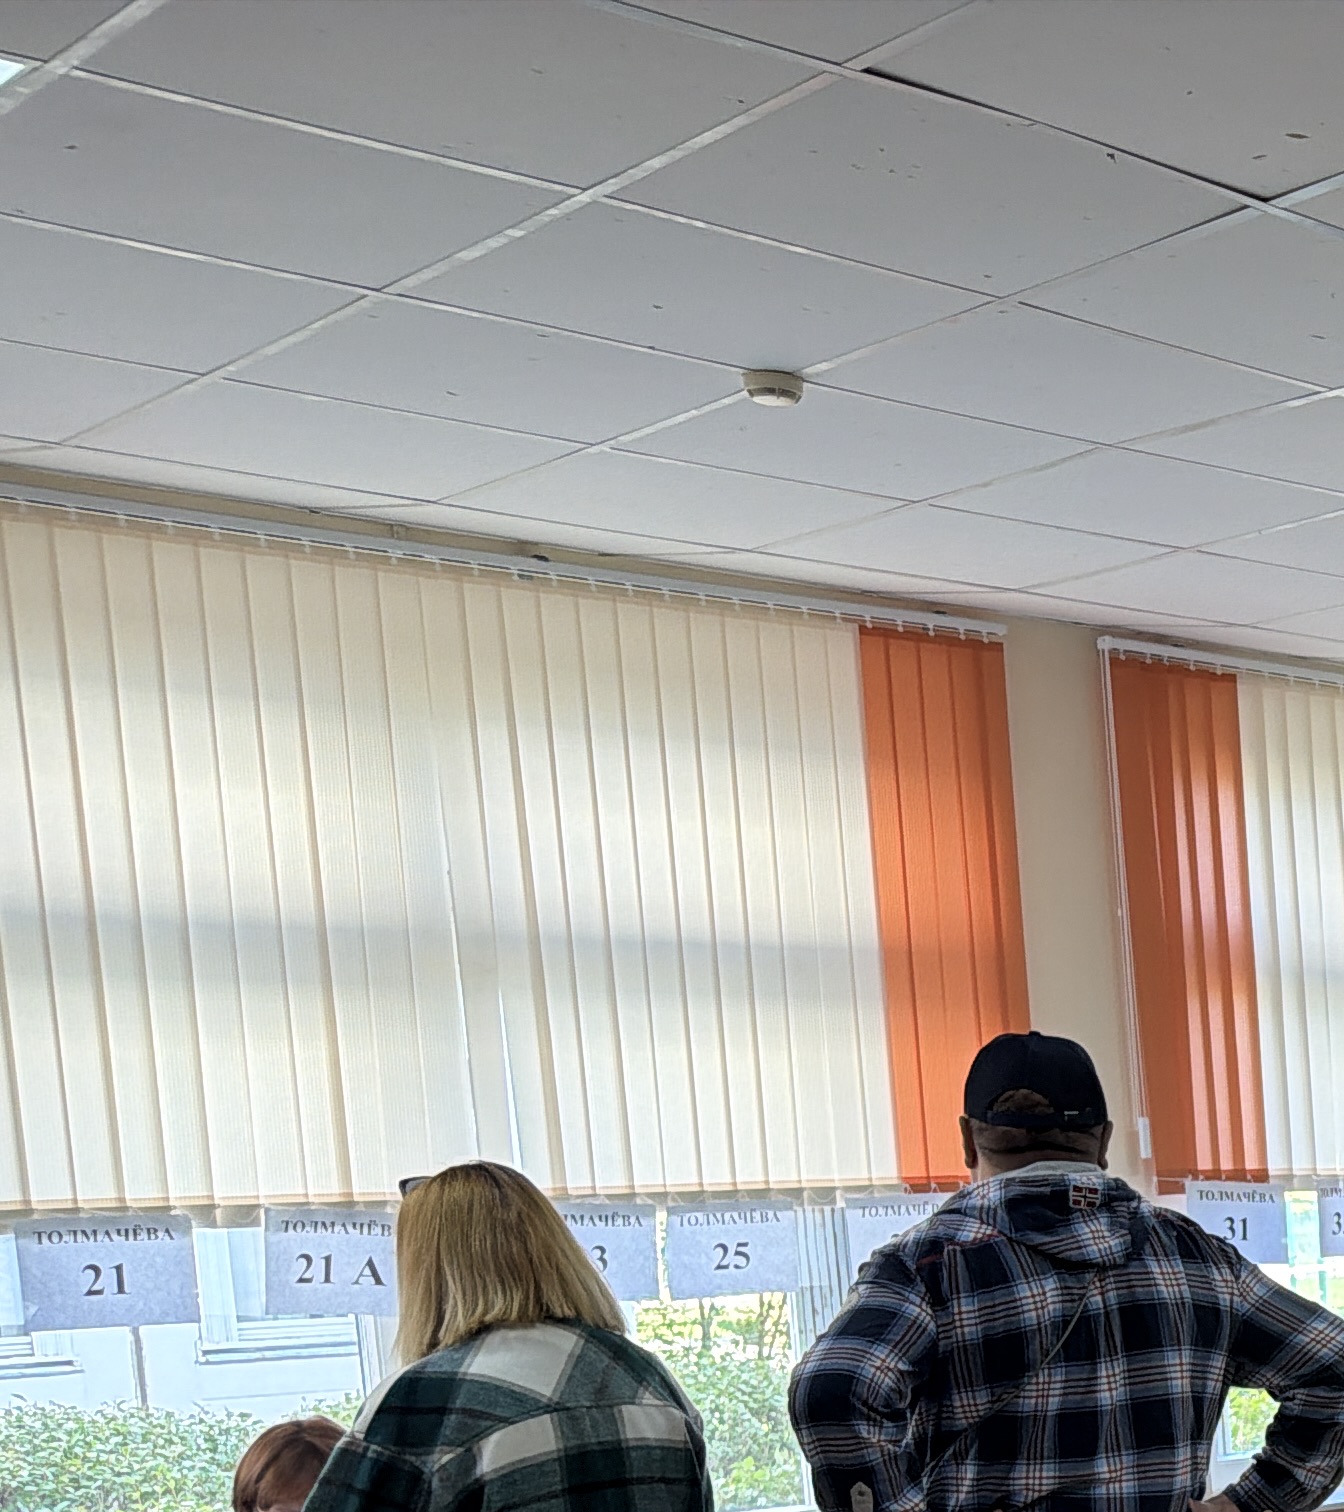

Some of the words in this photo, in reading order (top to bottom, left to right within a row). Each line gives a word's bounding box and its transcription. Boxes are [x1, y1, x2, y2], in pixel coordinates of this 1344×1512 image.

[1197, 1189, 1276, 1204] ТОЛМАЧЁВА
[562, 1211, 644, 1228] МАЧЁВА
[677, 1208, 782, 1228] ТОЛМАЧЁВА
[859, 1201, 940, 1219] ТОЛМАЧЁ
[33, 1223, 176, 1247] ТОЛМАЧЁВА
[281, 1217, 393, 1238] ТОЛМАЧЁВ
[1223, 1216, 1248, 1241] 31
[591, 1245, 608, 1273] 3
[713, 1241, 751, 1271] 25
[81, 1262, 131, 1298] 21
[295, 1252, 336, 1286] 21
[351, 1255, 387, 1287] А
